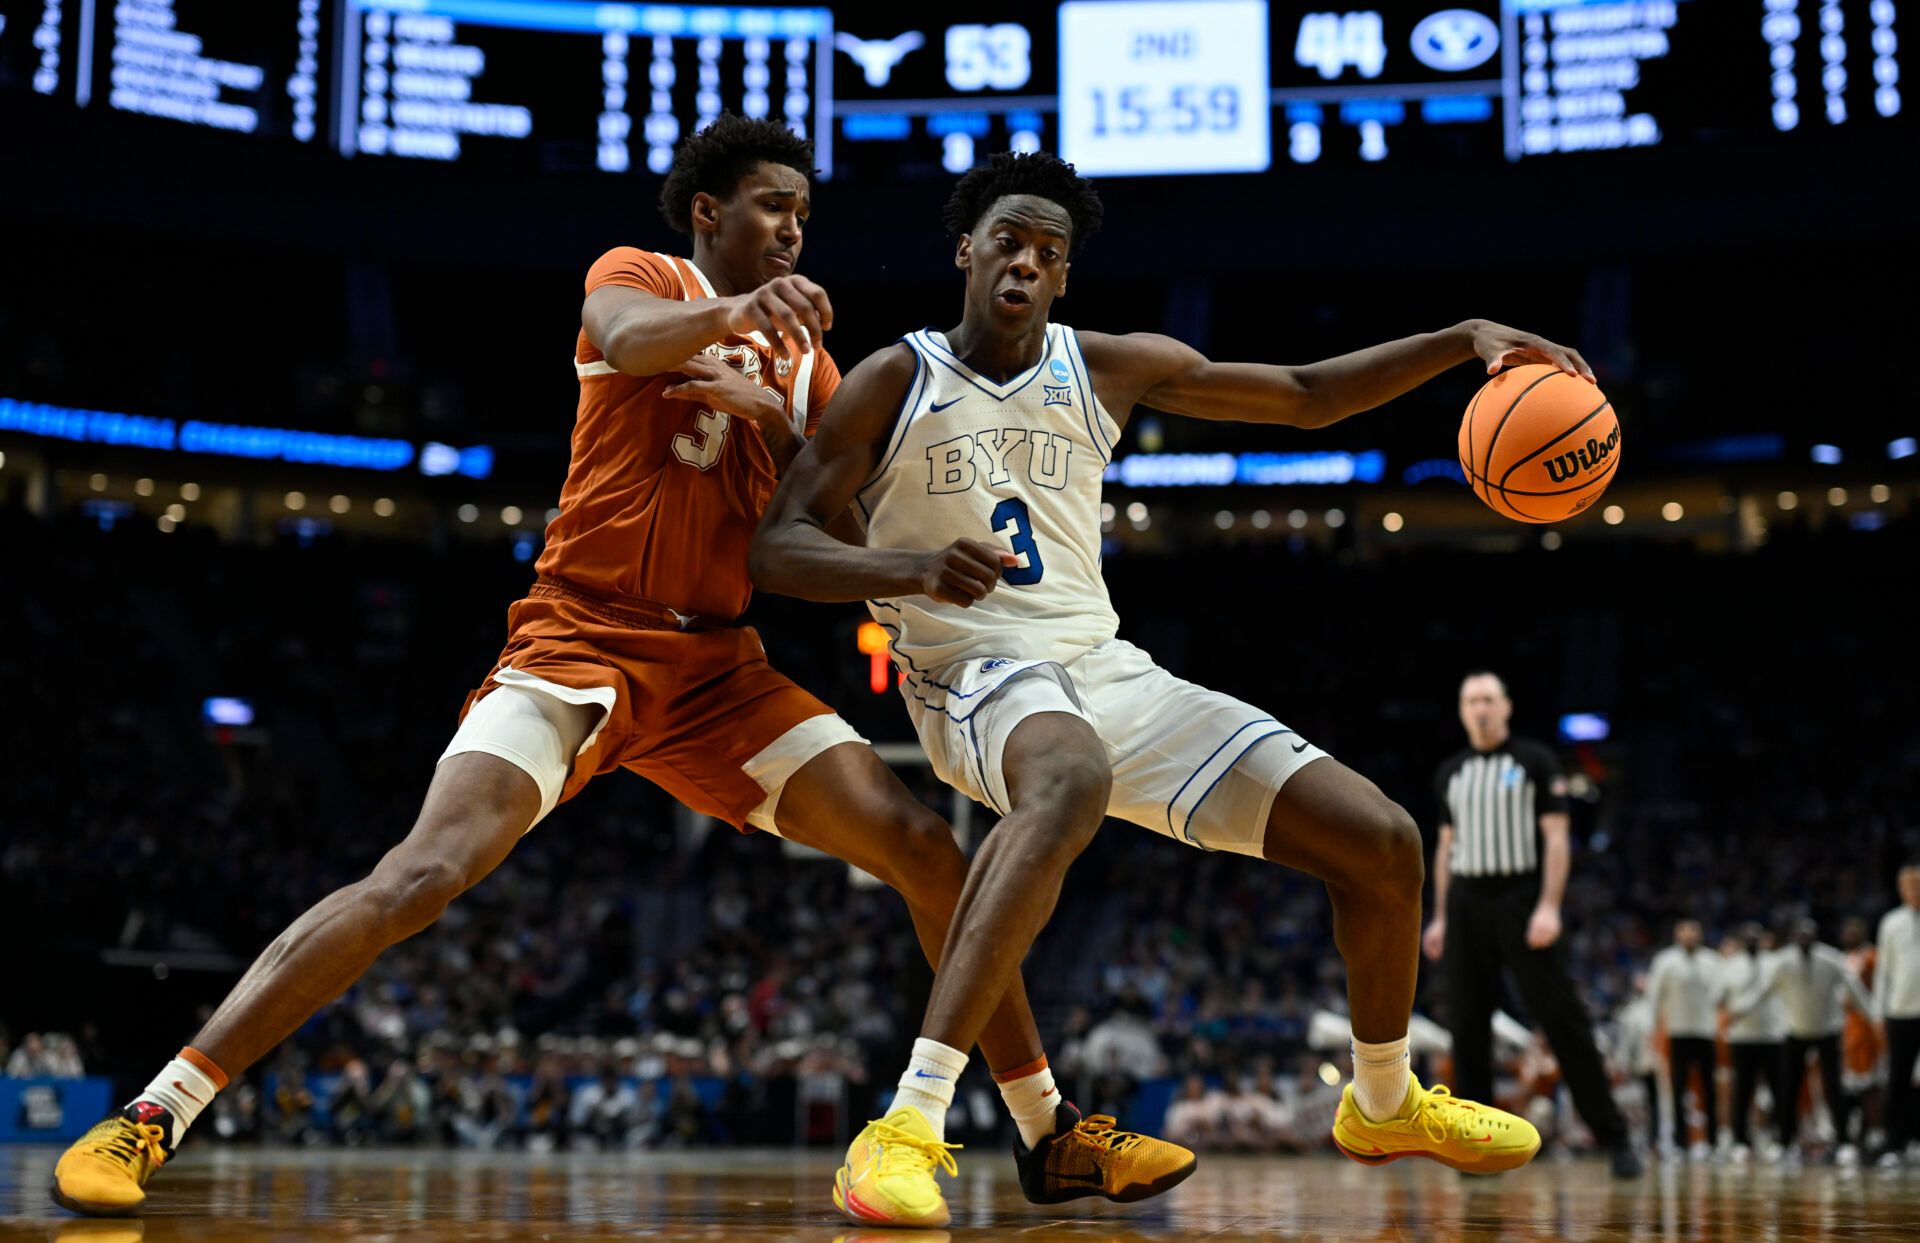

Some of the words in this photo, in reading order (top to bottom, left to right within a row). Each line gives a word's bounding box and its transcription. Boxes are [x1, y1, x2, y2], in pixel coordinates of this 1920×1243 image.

[945, 23, 1031, 91] 53
[1295, 11, 1387, 80] 44
[1089, 84, 1243, 138] 15:59
[671, 409, 730, 471] 3
[926, 428, 1072, 495] BYU
[1543, 423, 1619, 483] Wilson
[990, 496, 1044, 585] 3
